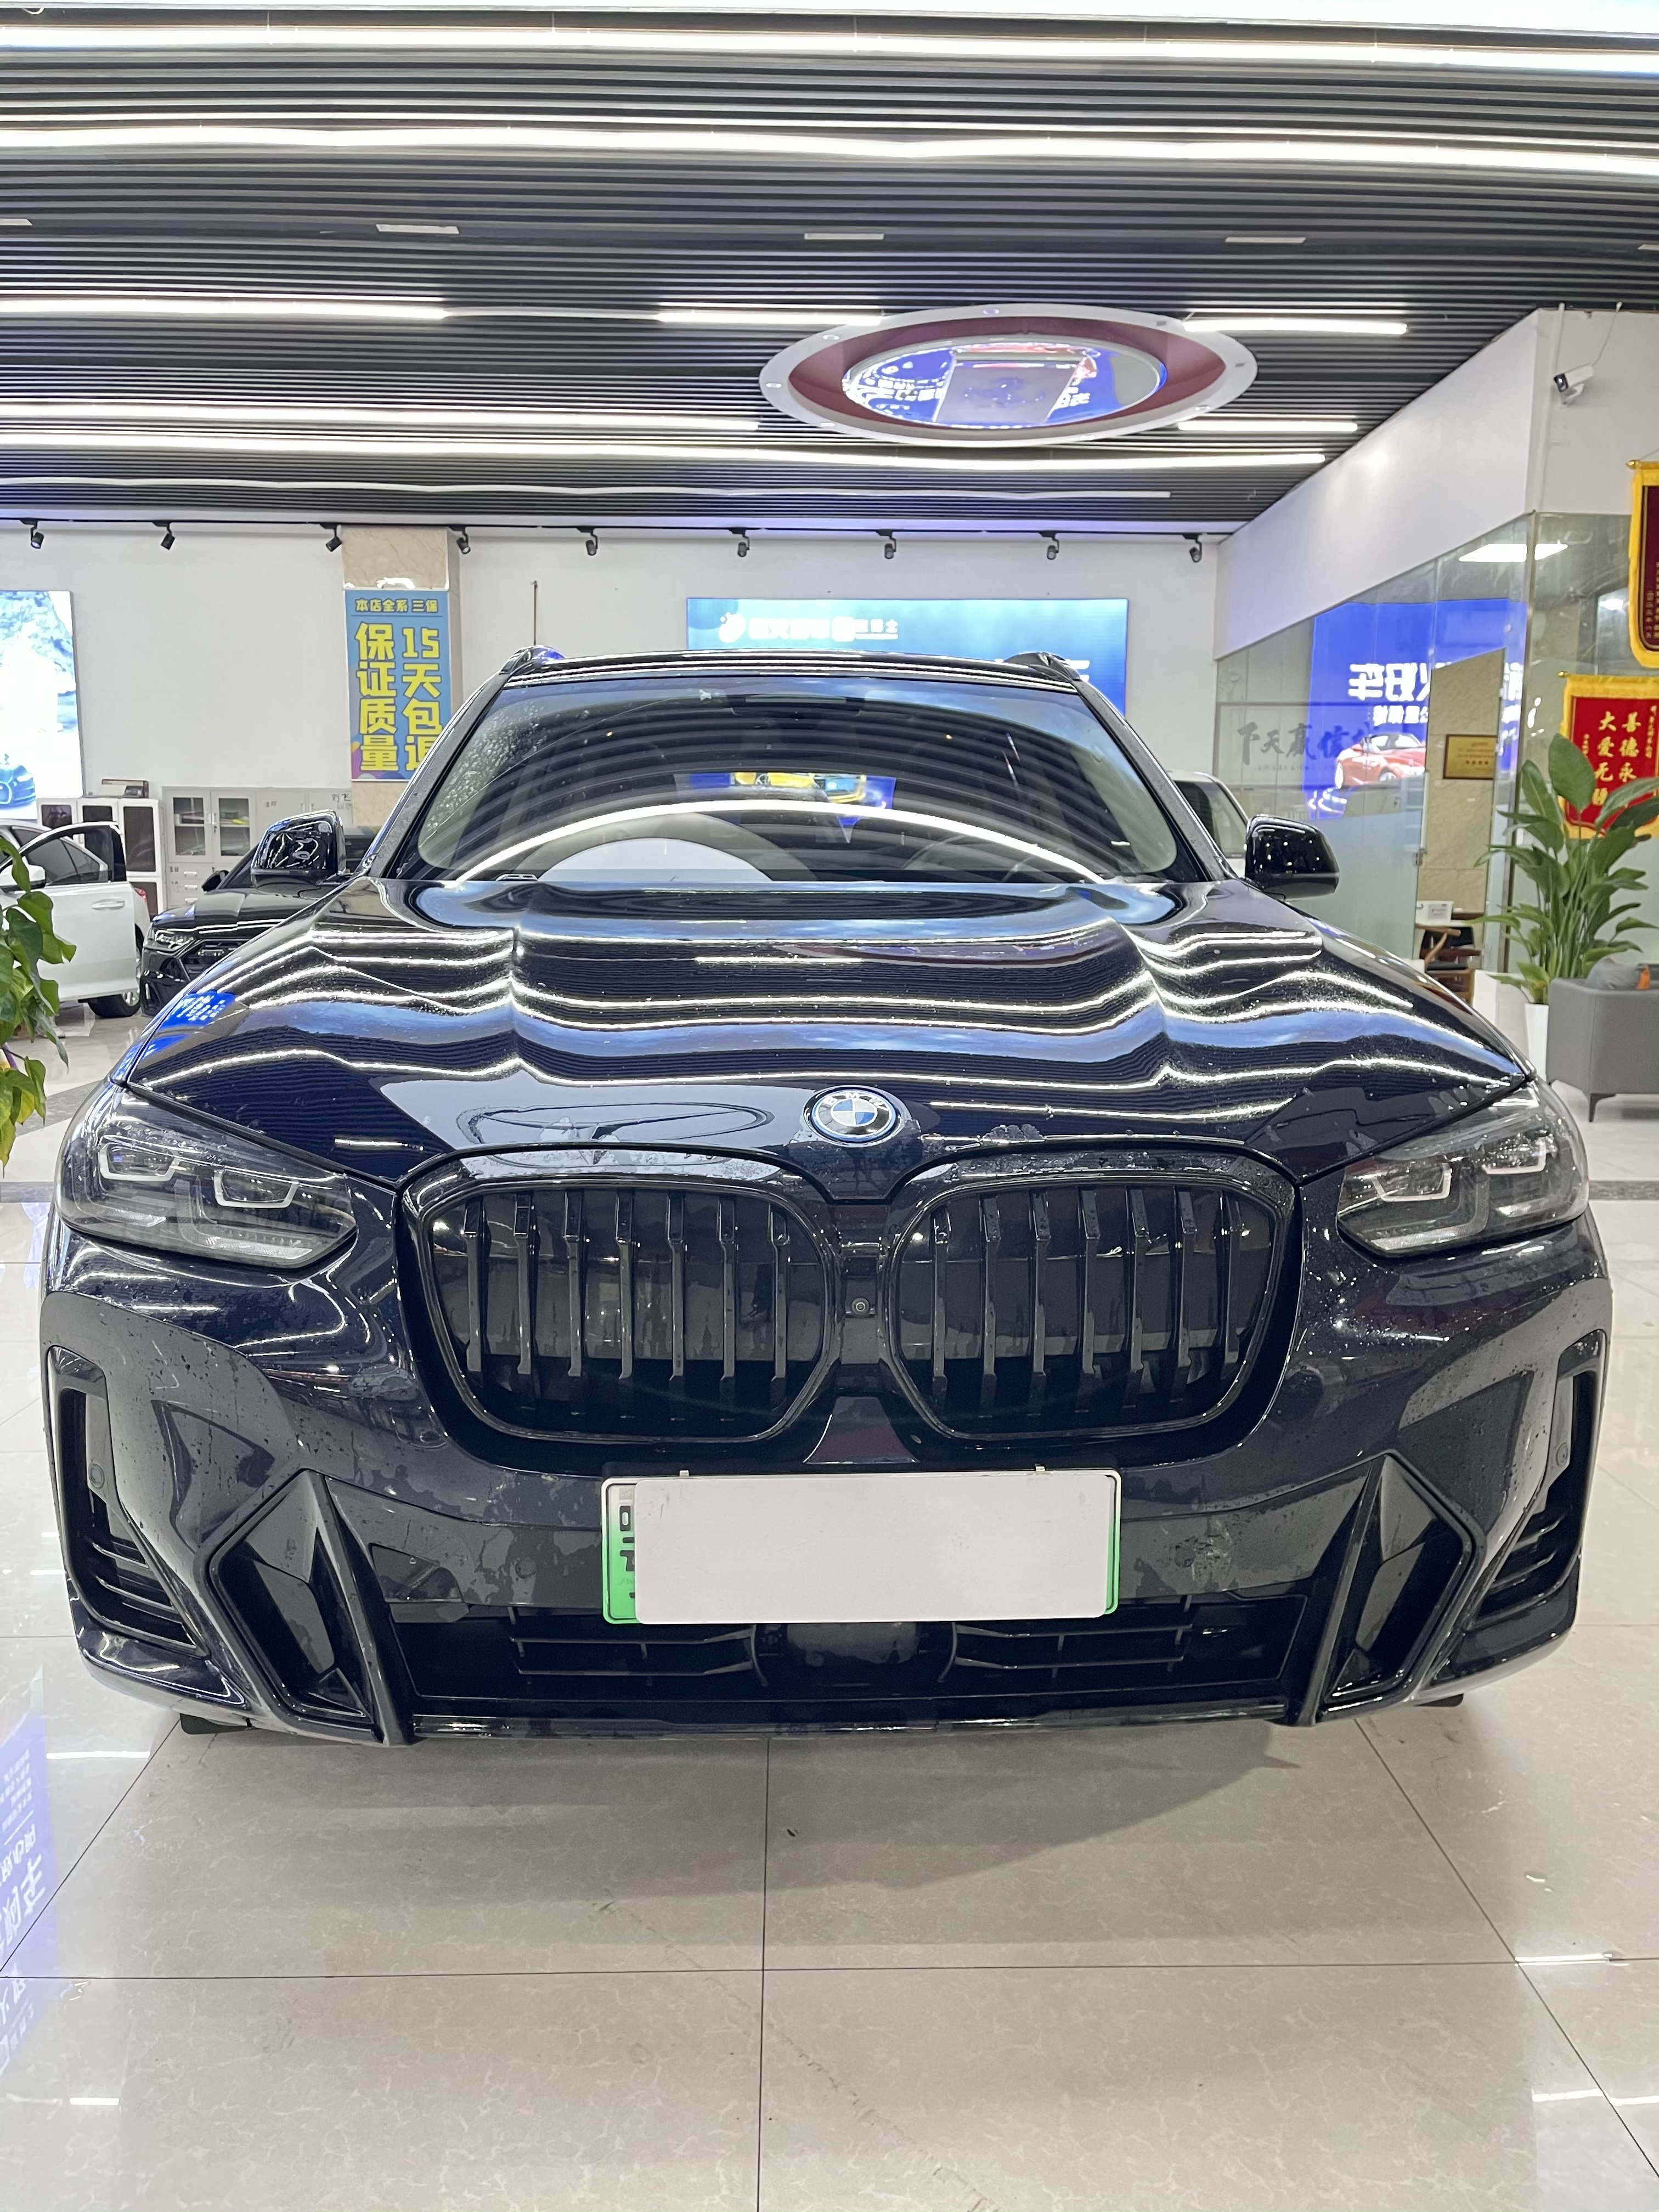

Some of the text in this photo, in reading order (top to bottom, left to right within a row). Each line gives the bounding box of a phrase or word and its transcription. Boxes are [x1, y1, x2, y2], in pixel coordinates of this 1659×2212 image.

[355, 598, 408, 612] 本店全系
[354, 622, 399, 771] 保证质量
